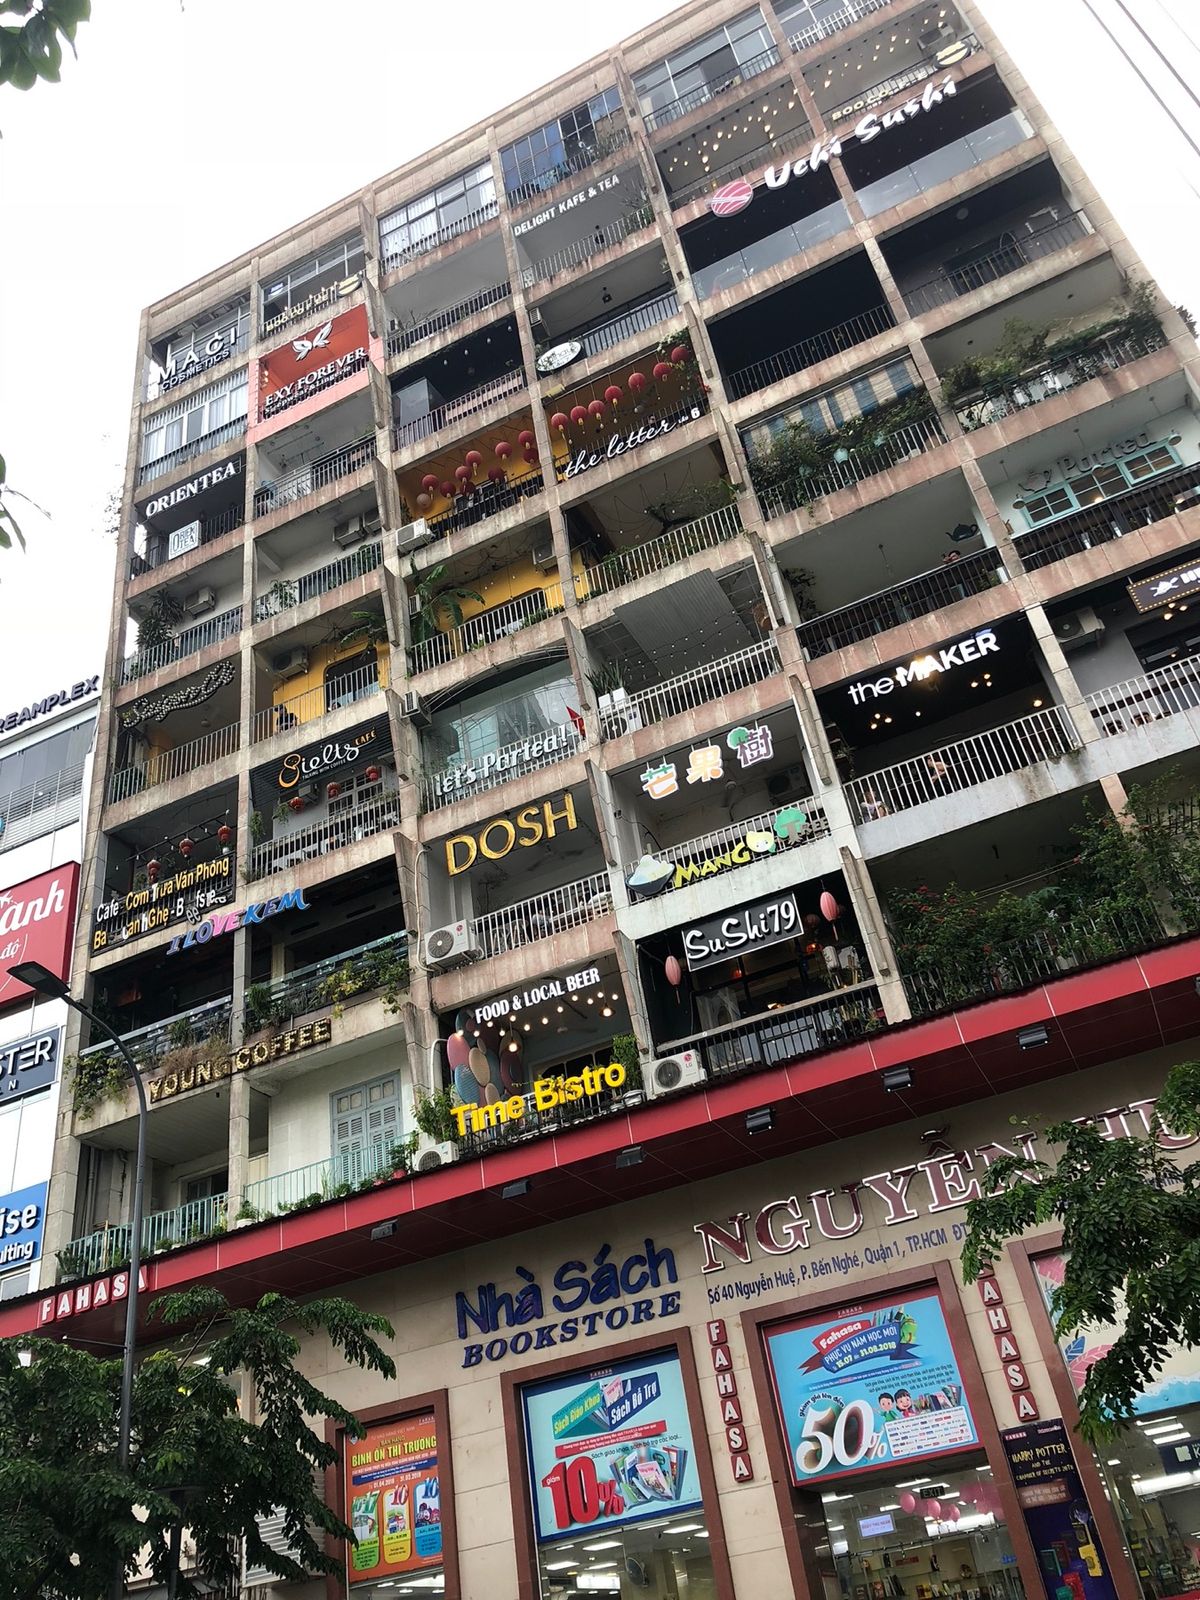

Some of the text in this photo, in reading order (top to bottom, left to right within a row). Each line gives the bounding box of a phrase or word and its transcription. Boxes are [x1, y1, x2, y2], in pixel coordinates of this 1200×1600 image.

[764, 74, 958, 190] Uchi Sushi
[513, 174, 620, 237] DELIGHT KAFE & TEA
[161, 348, 230, 390] COSMETICS
[297, 346, 369, 390] FOREVER
[564, 449, 604, 479] the
[606, 419, 677, 459] letter
[145, 461, 237, 518] ORIENTEA
[848, 631, 1001, 705] the MAKER
[444, 793, 579, 878] DOSH
[181, 907, 245, 950] LOVE
[242, 886, 313, 928] KEM
[475, 966, 601, 1025] FOOD & LOCAL BEER
[149, 1019, 331, 1099] YOUNG COFFEE
[450, 1062, 627, 1137] Time Bistro
[455, 1237, 679, 1340] Nhà Sách
[707, 1283, 721, 1305] Số
[721, 1283, 734, 1302] 40
[735, 1271, 774, 1301] Nguyễn
[812, 1255, 832, 1279] Bến
[864, 1242, 893, 1265] Quận
[905, 1226, 949, 1252] TP.HCM
[461, 1290, 682, 1369] BOOKSTORE
[819, 1321, 863, 1350] Fahasa
[835, 1354, 853, 1369] 15.07
[859, 1341, 897, 1358] 31.08.2018
[611, 1399, 631, 1425] Sách
[708, 1320, 752, 1480] FAHASA
[795, 1399, 889, 1475] 50%
[1011, 1443, 1068, 1464] HARRY POTTER
[1031, 1461, 1042, 1469] AND
[541, 1455, 626, 1530] 10%
[922, 1488, 943, 1498] EXIT
